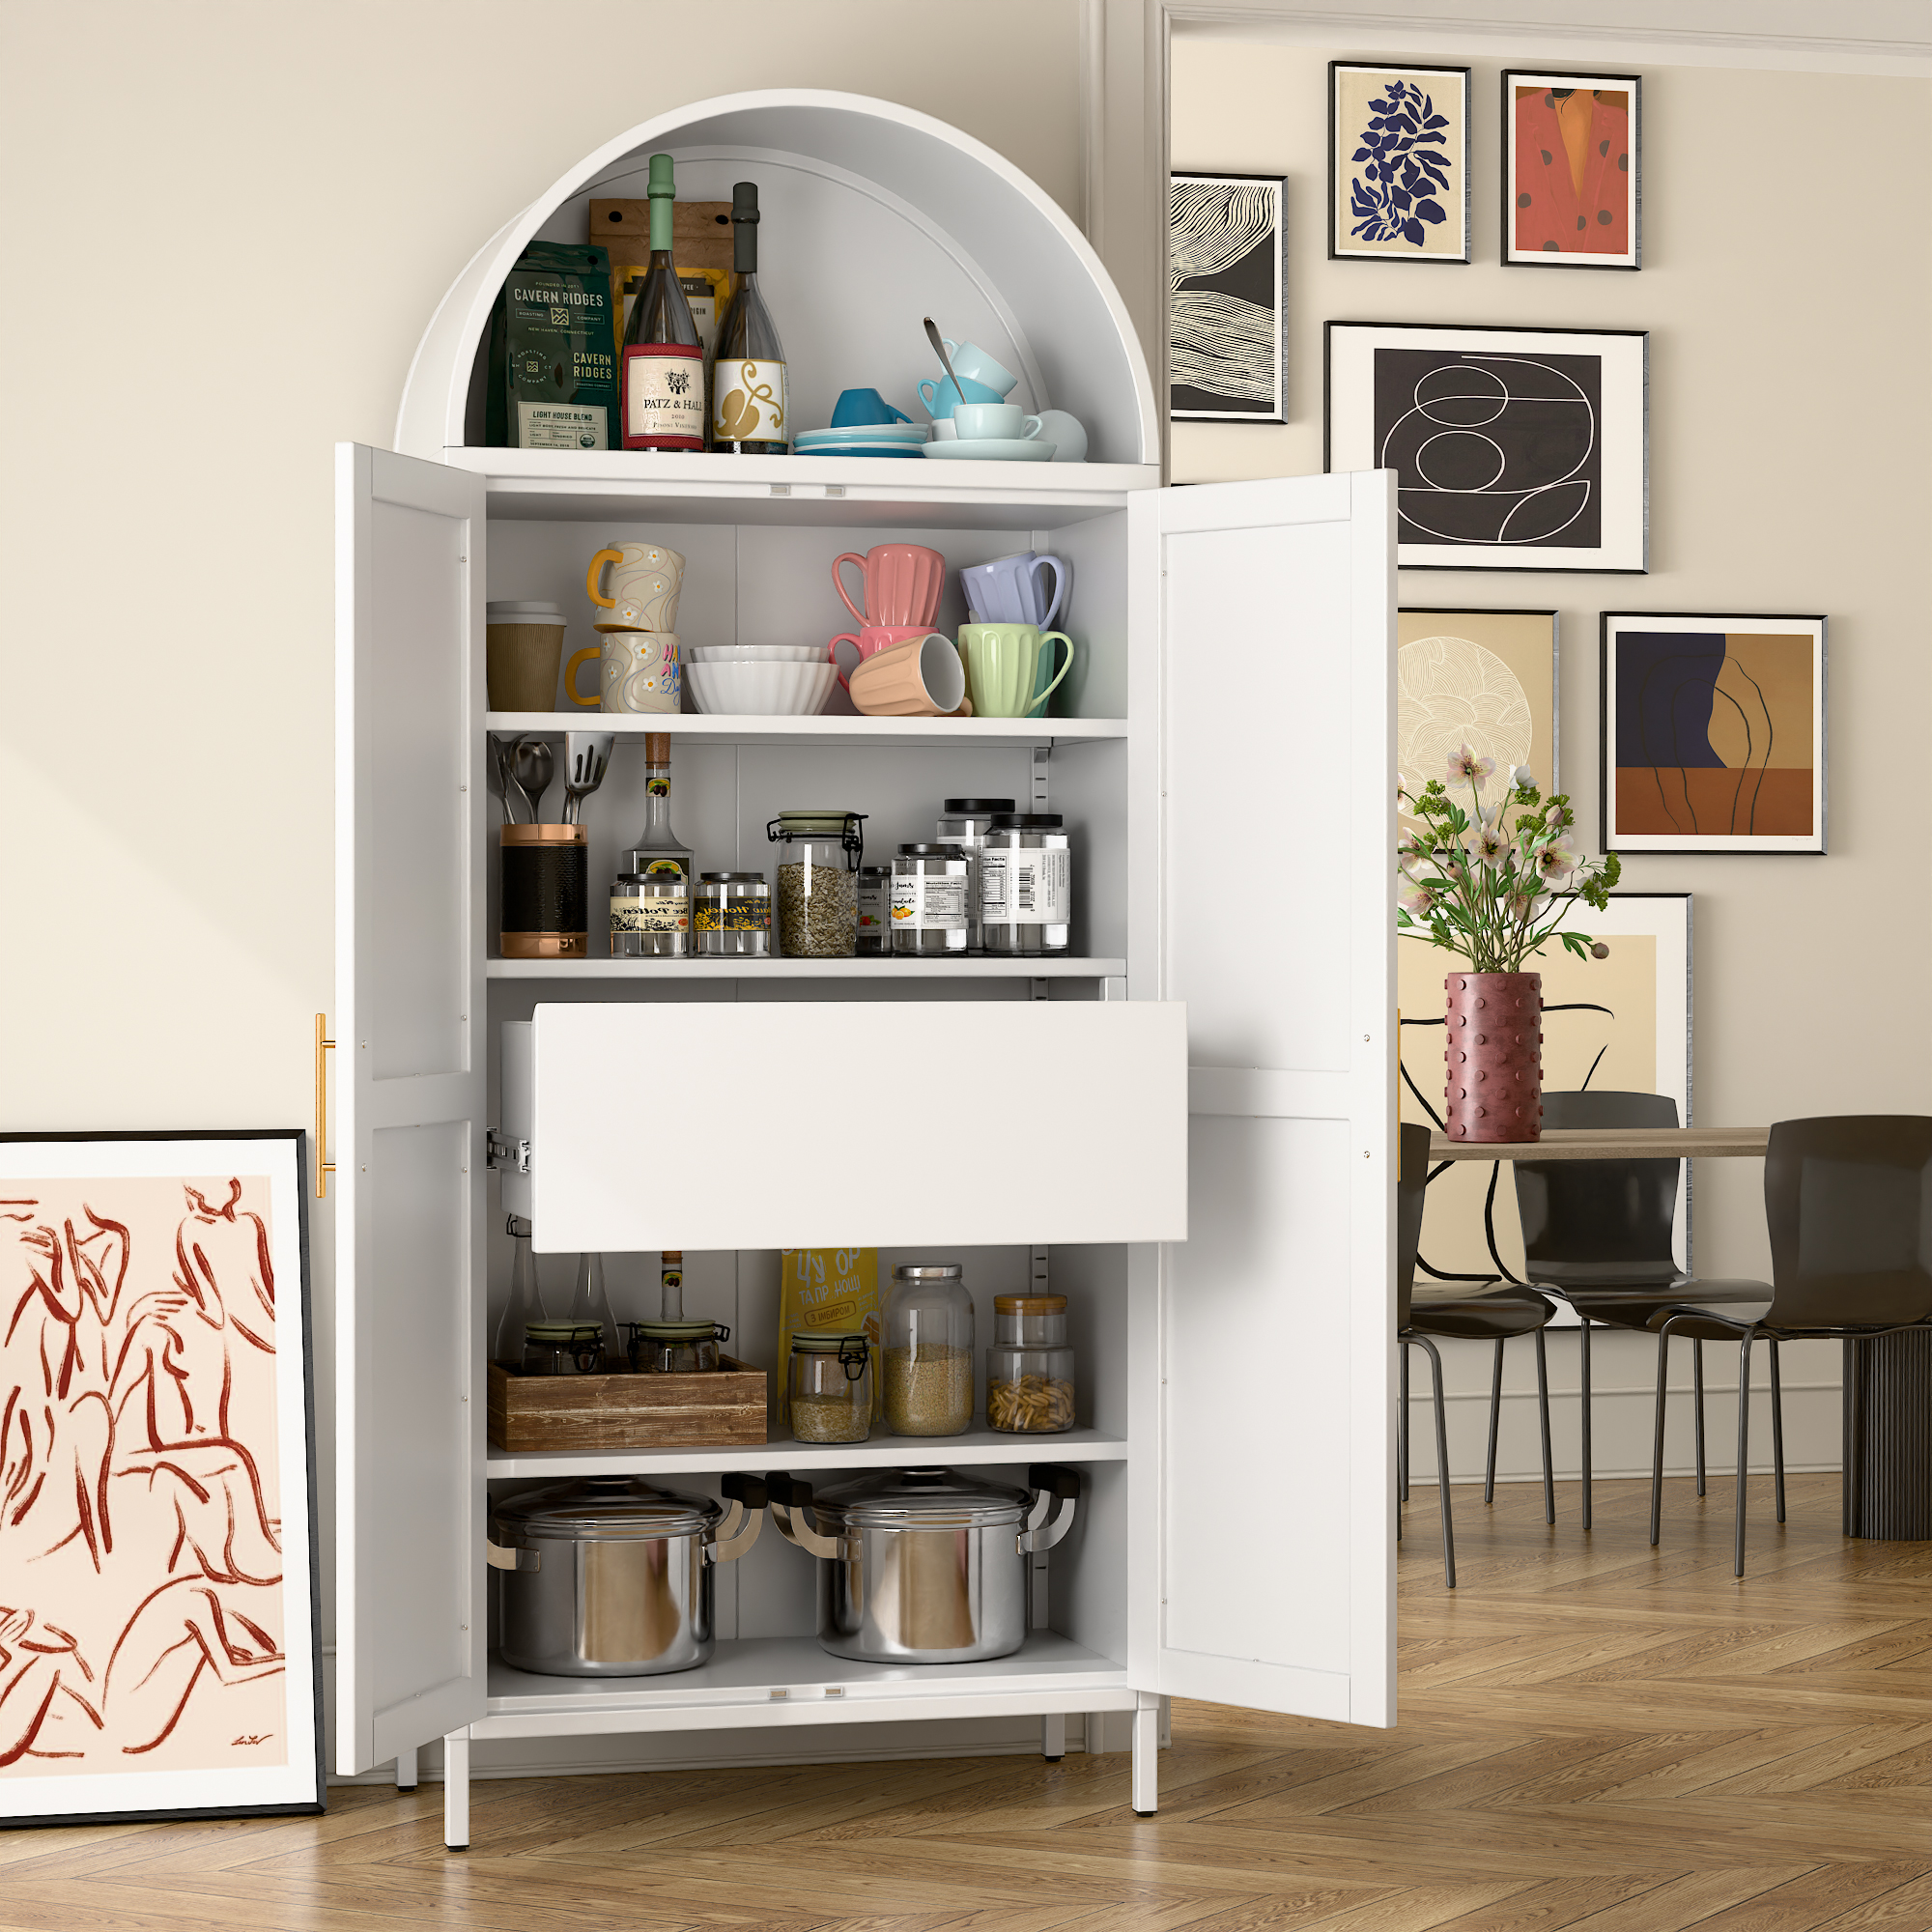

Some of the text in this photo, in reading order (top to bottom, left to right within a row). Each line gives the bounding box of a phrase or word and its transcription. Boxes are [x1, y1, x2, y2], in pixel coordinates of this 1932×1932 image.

[514, 288, 604, 307] CAVERN RIDGES
[517, 349, 547, 360] ROASTING
[573, 352, 611, 366] CAVERN
[518, 374, 547, 384] COMPANY
[573, 365, 612, 380] RIDGES
[643, 398, 702, 412] PATZ & HALL
[662, 642, 681, 663] HA
